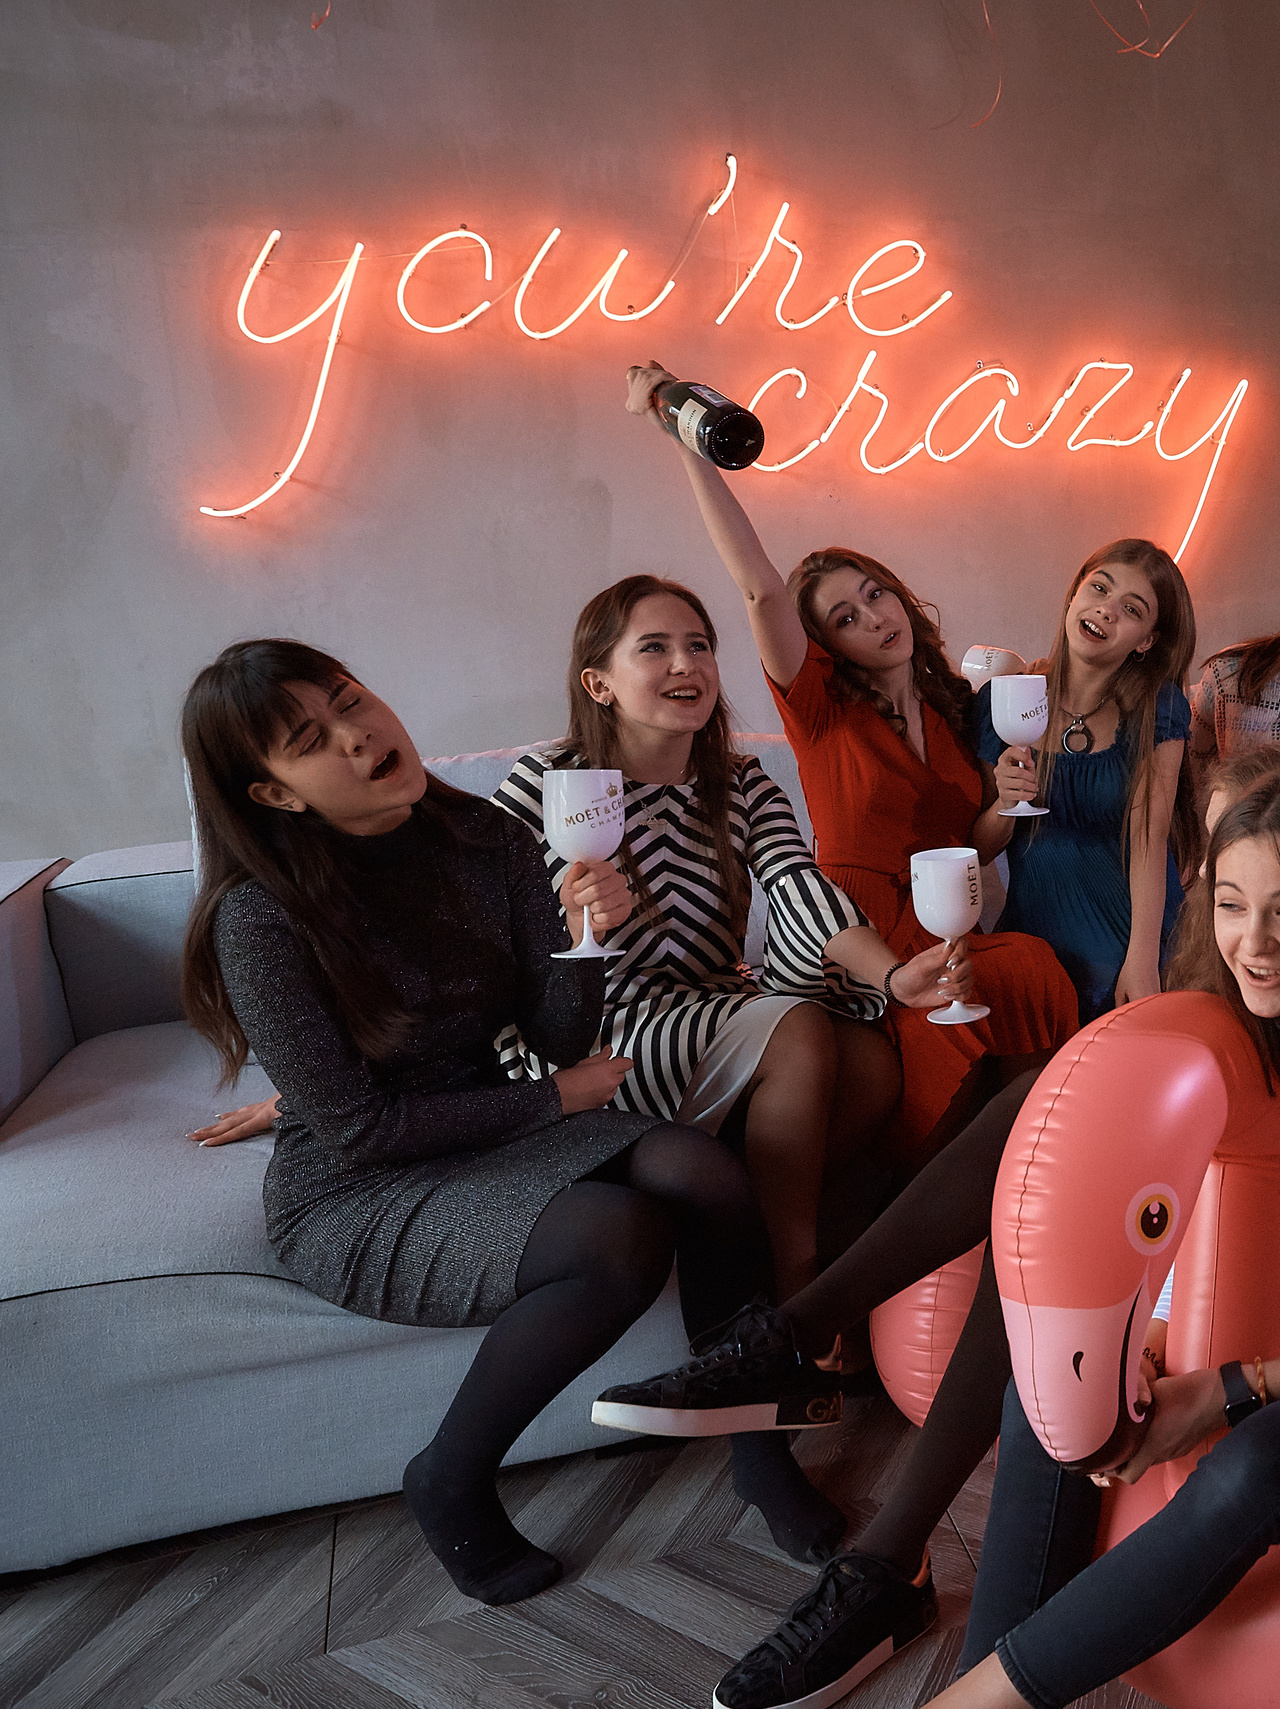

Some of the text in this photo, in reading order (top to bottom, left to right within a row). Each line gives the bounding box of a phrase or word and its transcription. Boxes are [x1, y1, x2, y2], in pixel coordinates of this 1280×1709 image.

[199, 155, 953, 518] you're
[747, 350, 1249, 565] crazy
[603, 805, 611, 815] &
